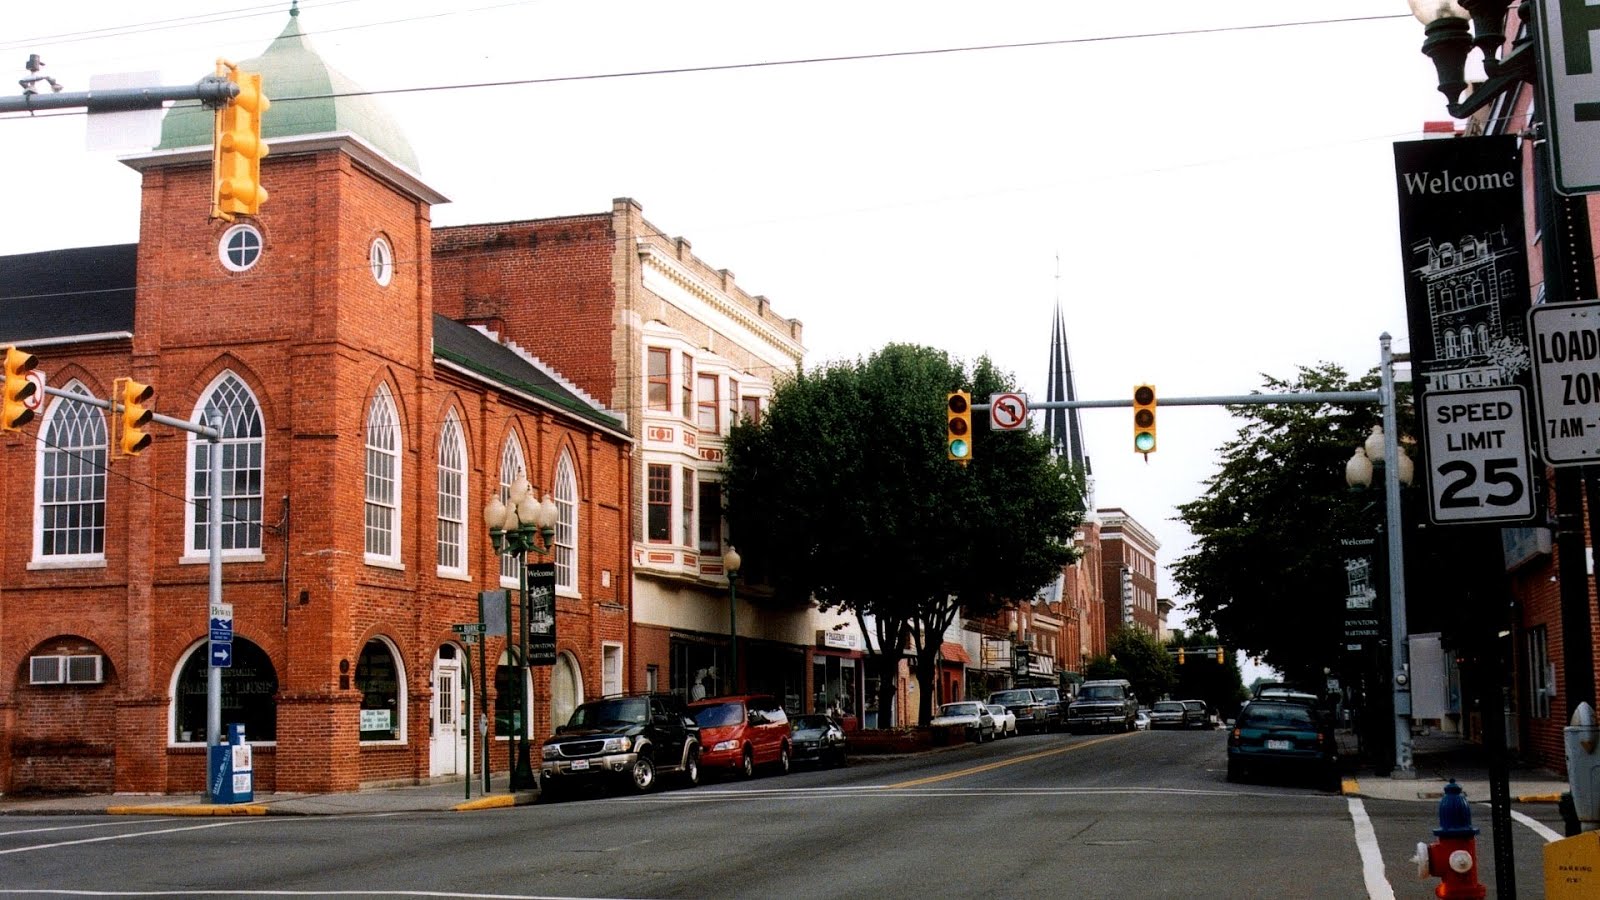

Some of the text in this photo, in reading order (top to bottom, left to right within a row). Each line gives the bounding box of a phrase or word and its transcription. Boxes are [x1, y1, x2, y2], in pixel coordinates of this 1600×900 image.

[1403, 169, 1515, 195] Welcome
[1437, 402, 1513, 424] SPEED
[1447, 430, 1505, 452] LIMIT
[1437, 458, 1524, 510] 25
[1340, 537, 1375, 546] Welcome
[528, 569, 554, 577] Welcome
